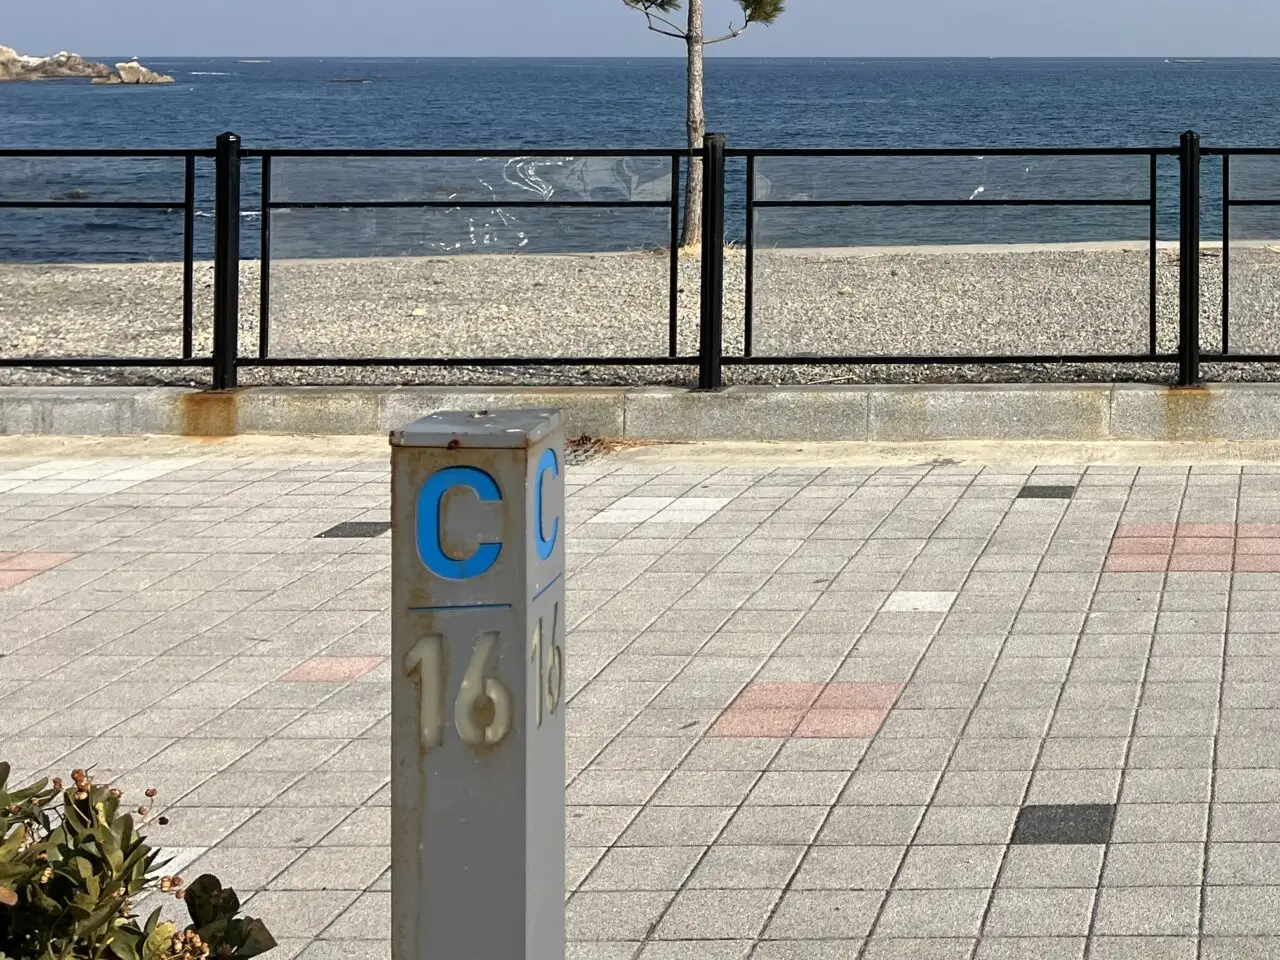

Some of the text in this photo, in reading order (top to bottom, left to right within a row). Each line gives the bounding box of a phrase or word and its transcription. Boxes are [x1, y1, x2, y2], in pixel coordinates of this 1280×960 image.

[415, 465, 503, 580] C
[535, 447, 559, 561] C
[404, 631, 512, 746] 16
[531, 602, 562, 728] 16
